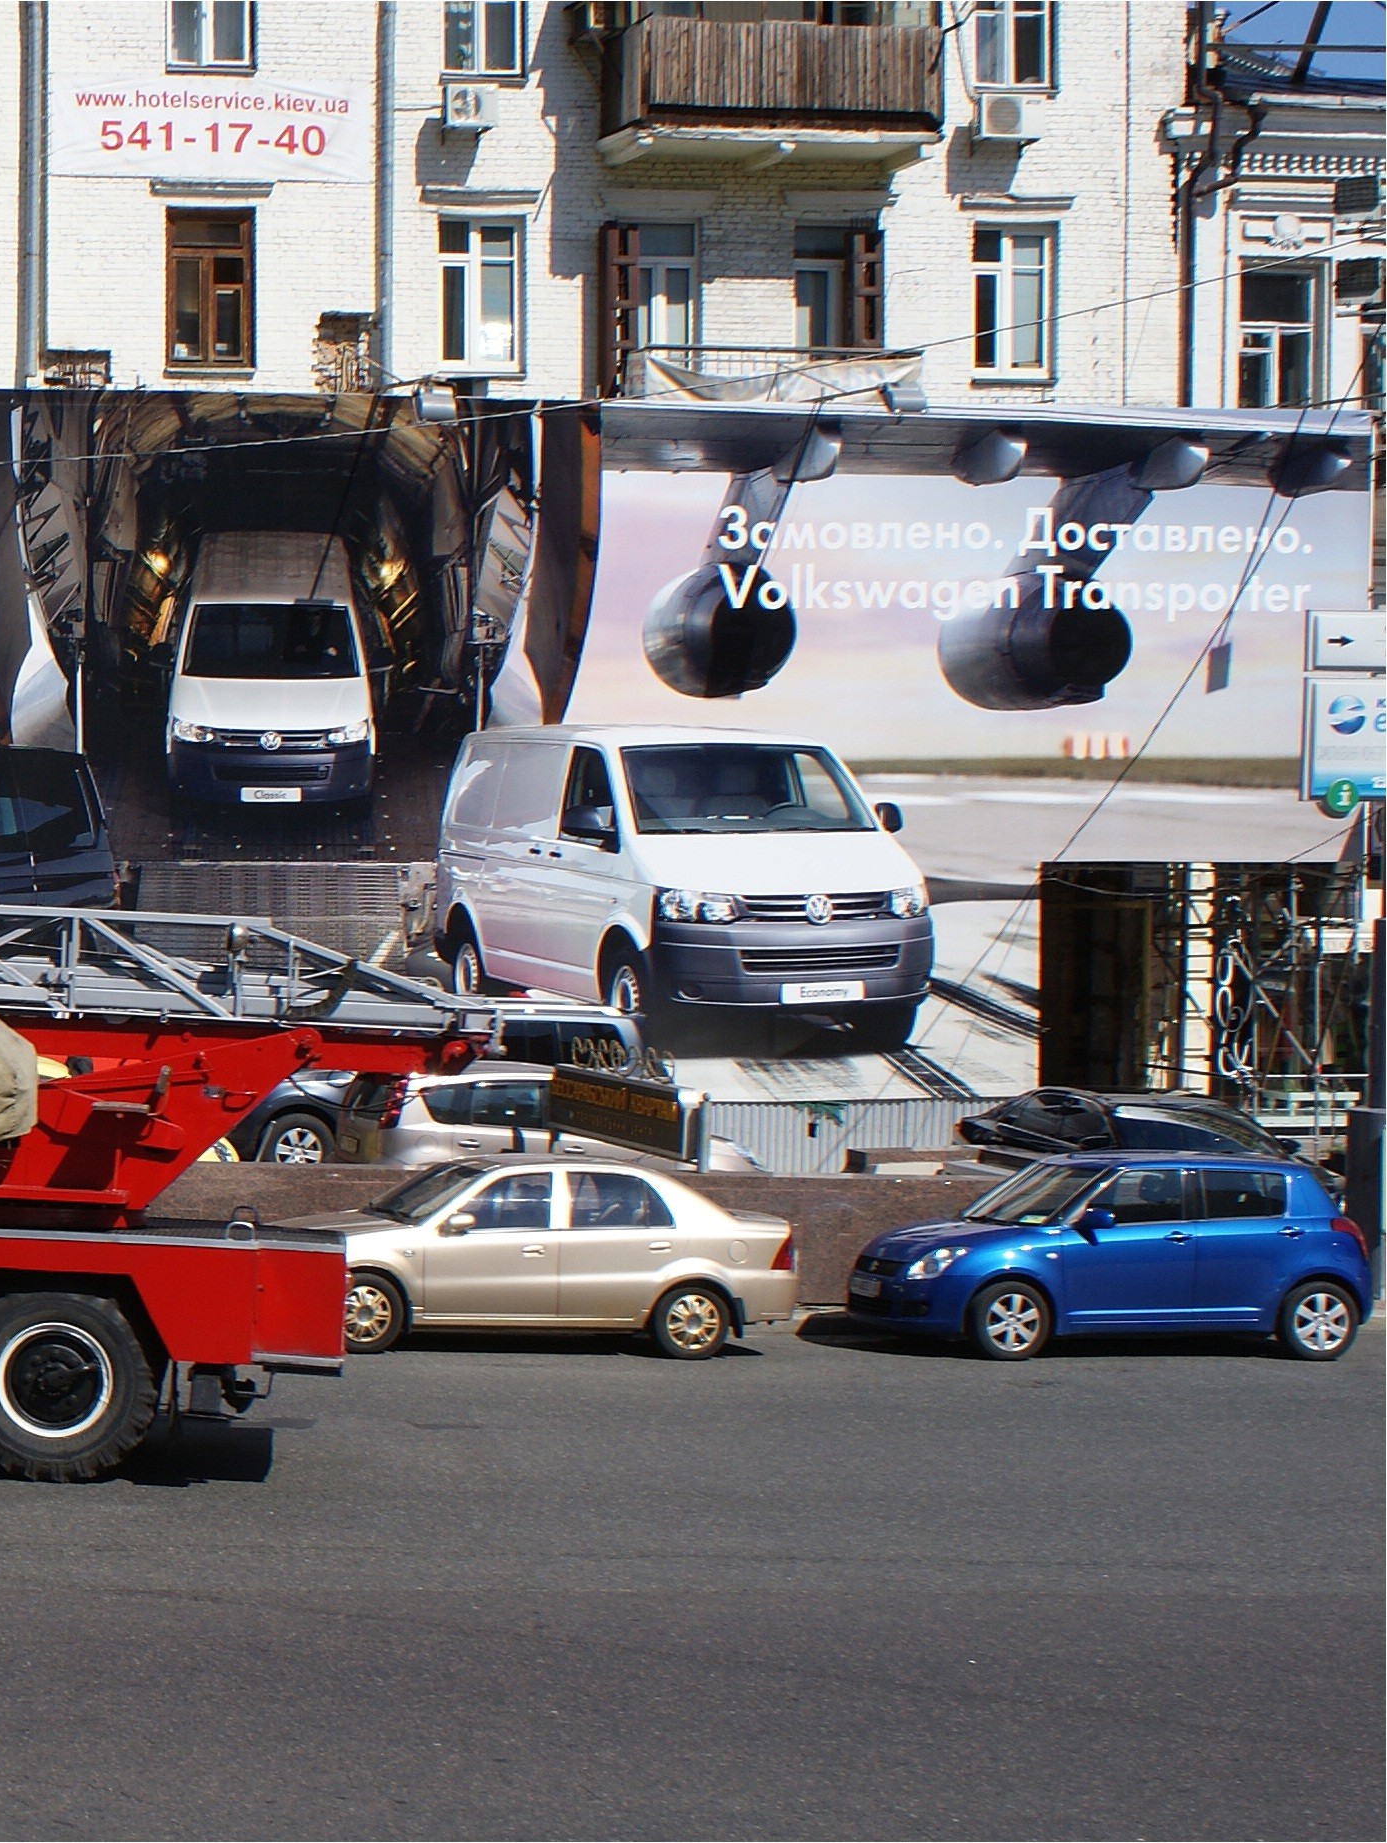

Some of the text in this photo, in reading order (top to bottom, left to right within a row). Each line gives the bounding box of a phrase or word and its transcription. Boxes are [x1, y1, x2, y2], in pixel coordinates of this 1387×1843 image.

[75, 89, 349, 114] www.hotelservice.kiev.ua
[100, 120, 327, 156] 541-17-40
[718, 505, 1312, 557] Замовлено. Доставлено.
[718, 563, 1312, 622] Volkswagen Transporter
[254, 789, 287, 800] Classic
[800, 986, 849, 998] Economy
